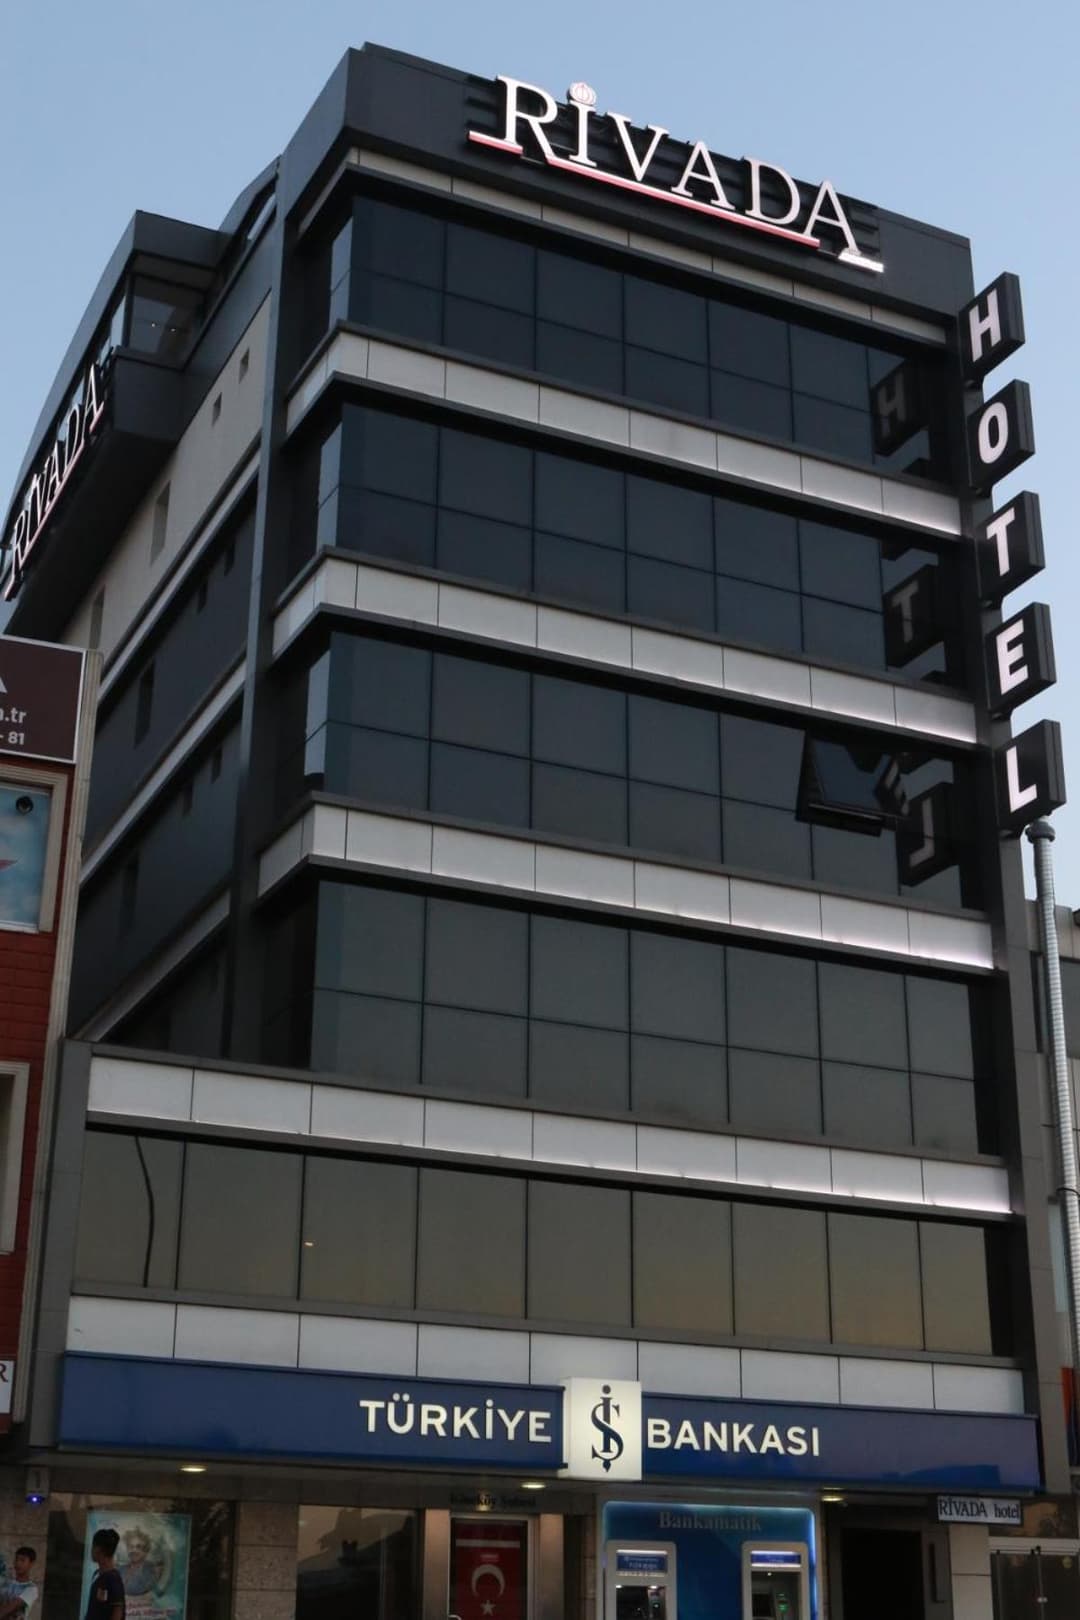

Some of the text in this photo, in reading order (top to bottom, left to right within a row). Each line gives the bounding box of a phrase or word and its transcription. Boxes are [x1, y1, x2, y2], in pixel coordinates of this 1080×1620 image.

[968, 288, 1038, 813] HOTEL
[8, 731, 25, 745] 81
[359, 1393, 552, 1443] TÜRKİYE
[647, 1418, 820, 1457] BANKASI
[659, 1511, 762, 1532] Bankamatik
[994, 1503, 1020, 1520] hotel
